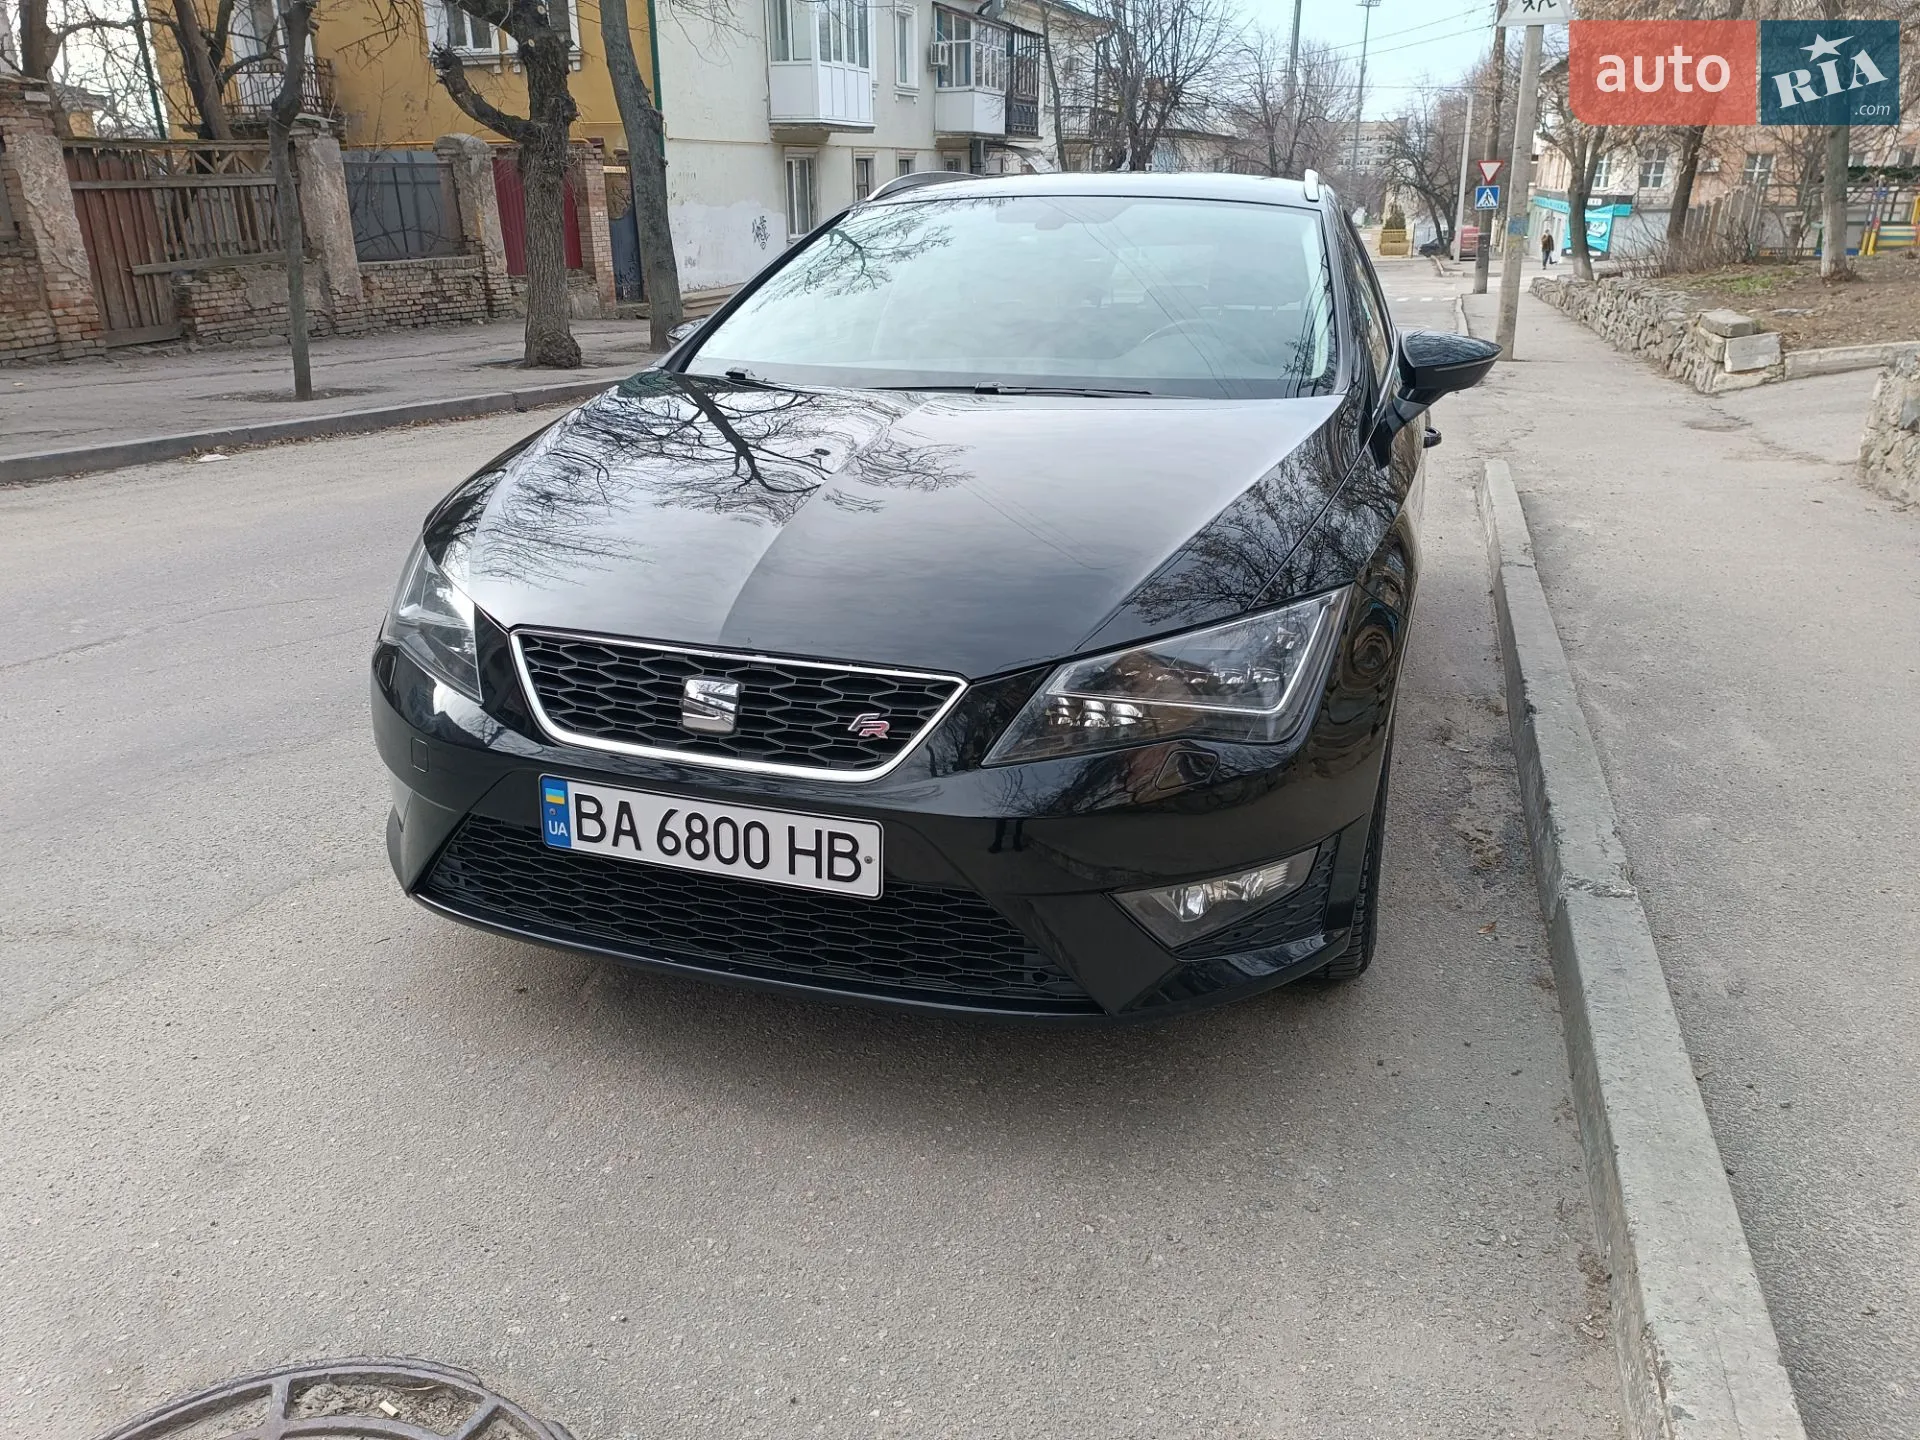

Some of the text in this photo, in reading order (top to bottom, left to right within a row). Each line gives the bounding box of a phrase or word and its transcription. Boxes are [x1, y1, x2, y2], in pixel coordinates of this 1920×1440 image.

[847, 712, 890, 740] FR
[548, 820, 569, 837] UA
[574, 792, 862, 883] BA 6800 HB
